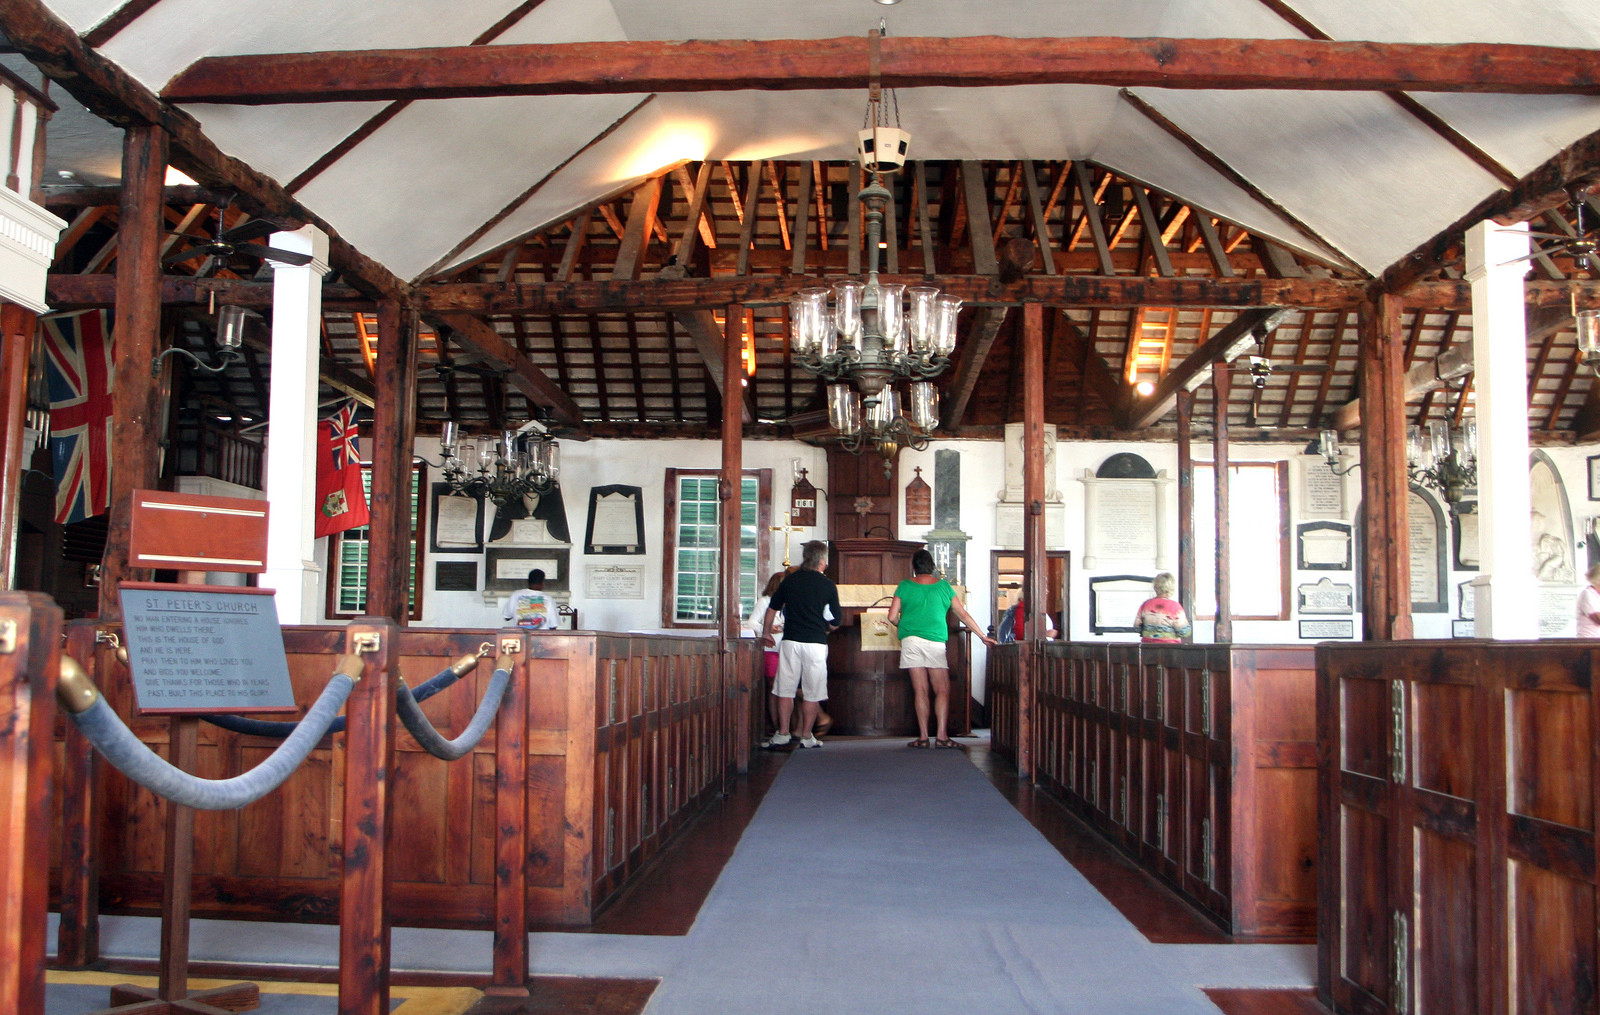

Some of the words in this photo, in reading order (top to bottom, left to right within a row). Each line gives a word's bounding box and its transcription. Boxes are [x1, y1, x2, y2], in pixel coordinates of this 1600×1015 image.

[146, 599, 162, 608] ST.
[168, 600, 212, 610] PETER'S
[216, 602, 258, 612] CHURCH
